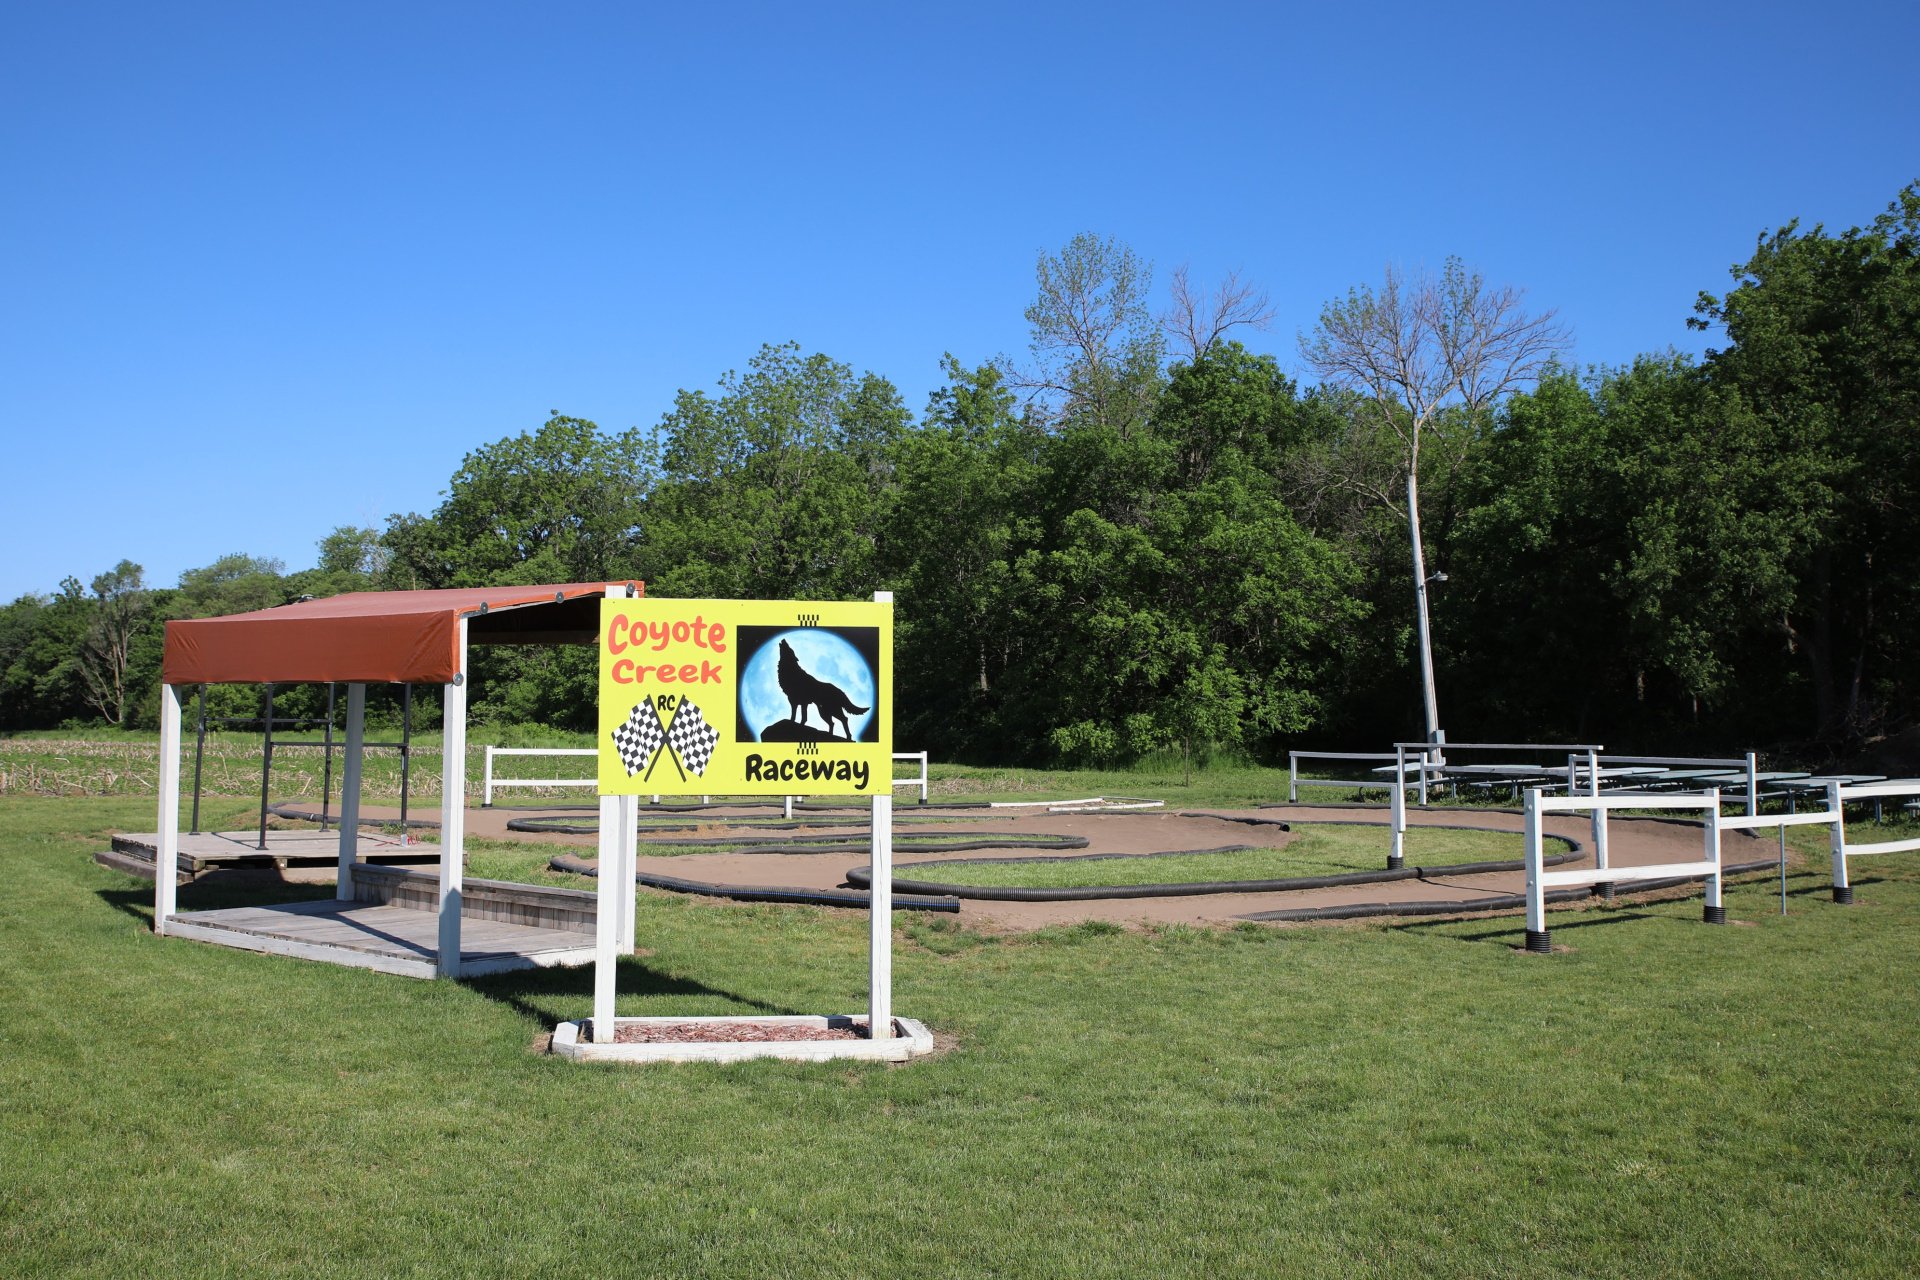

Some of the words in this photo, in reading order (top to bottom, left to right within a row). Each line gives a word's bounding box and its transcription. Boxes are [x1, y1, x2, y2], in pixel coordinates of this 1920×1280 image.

[608, 614, 727, 655] Coyote
[611, 659, 722, 684] Creek
[657, 694, 676, 712] RC
[745, 753, 870, 790] Raceway
